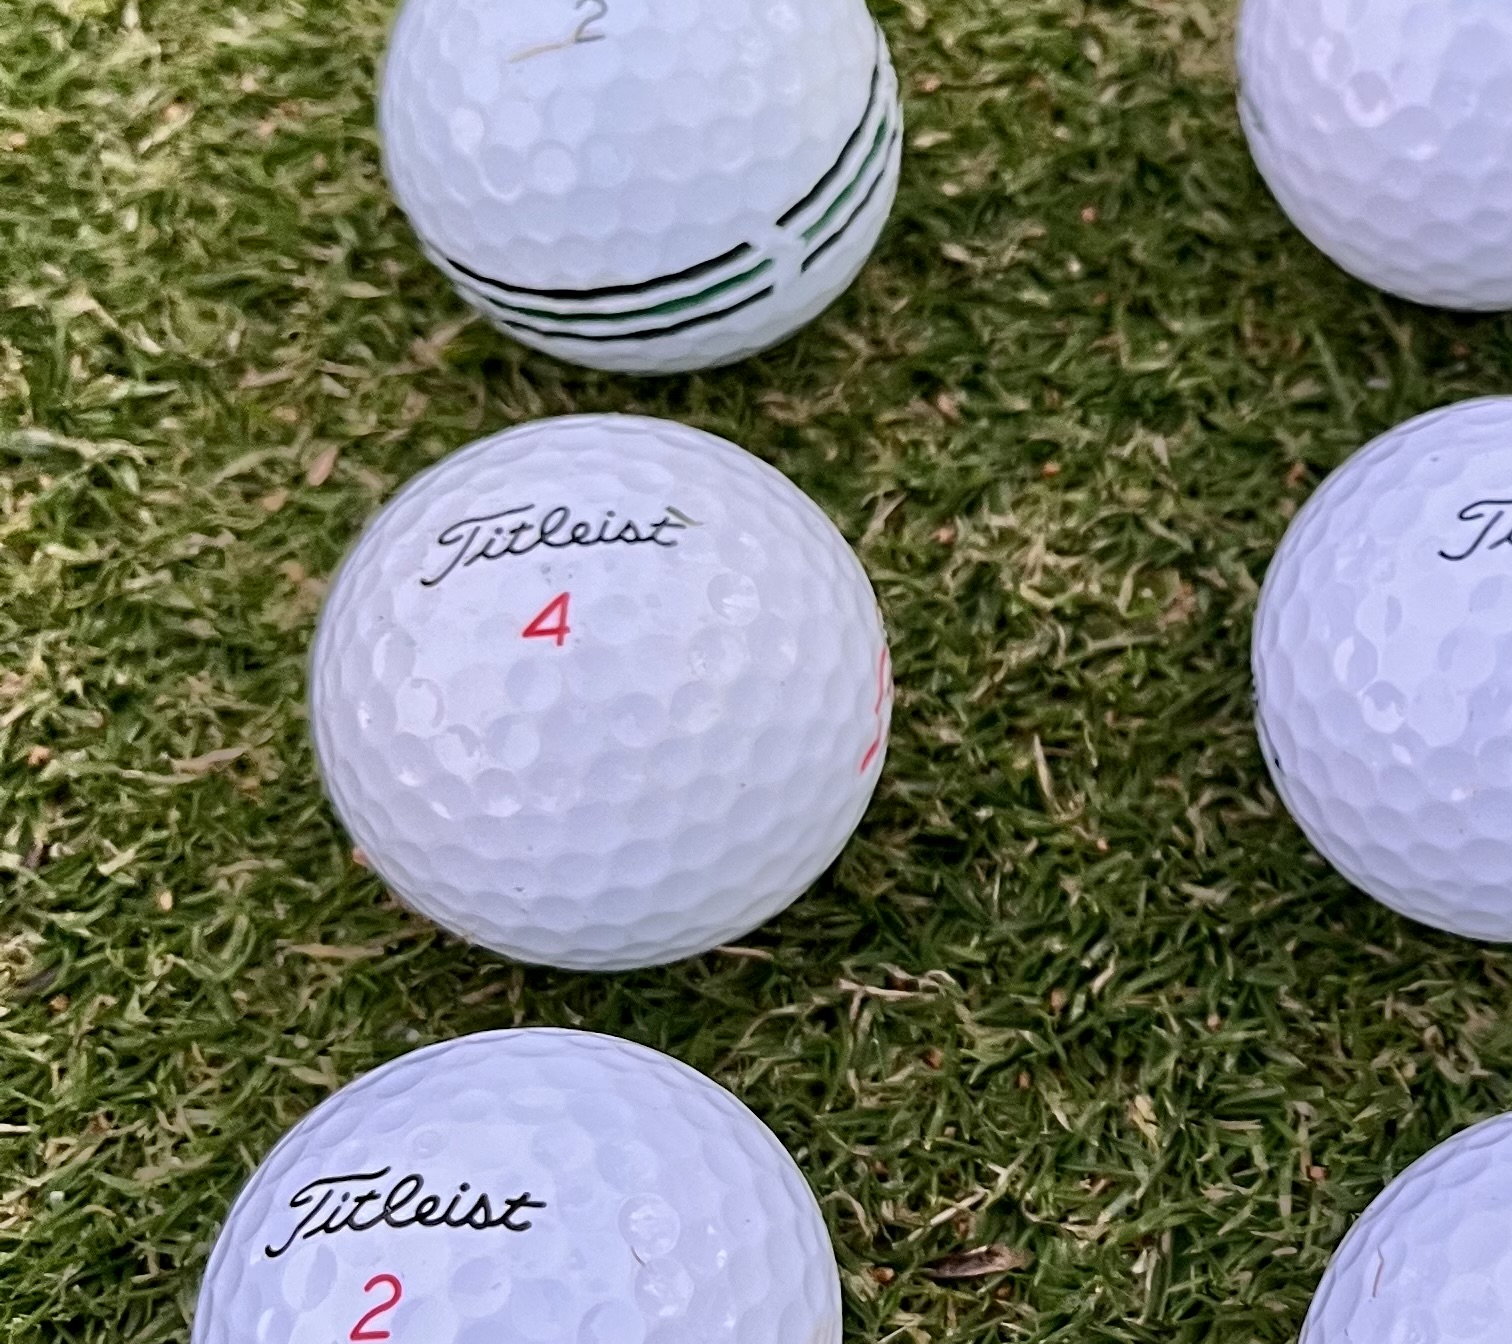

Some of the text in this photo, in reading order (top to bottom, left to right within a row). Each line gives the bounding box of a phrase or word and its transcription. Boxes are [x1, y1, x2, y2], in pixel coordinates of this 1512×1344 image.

[420, 503, 696, 587] Titleist
[521, 591, 572, 647] 4
[265, 1165, 547, 1260] Titleist
[349, 1272, 403, 1341] 2
